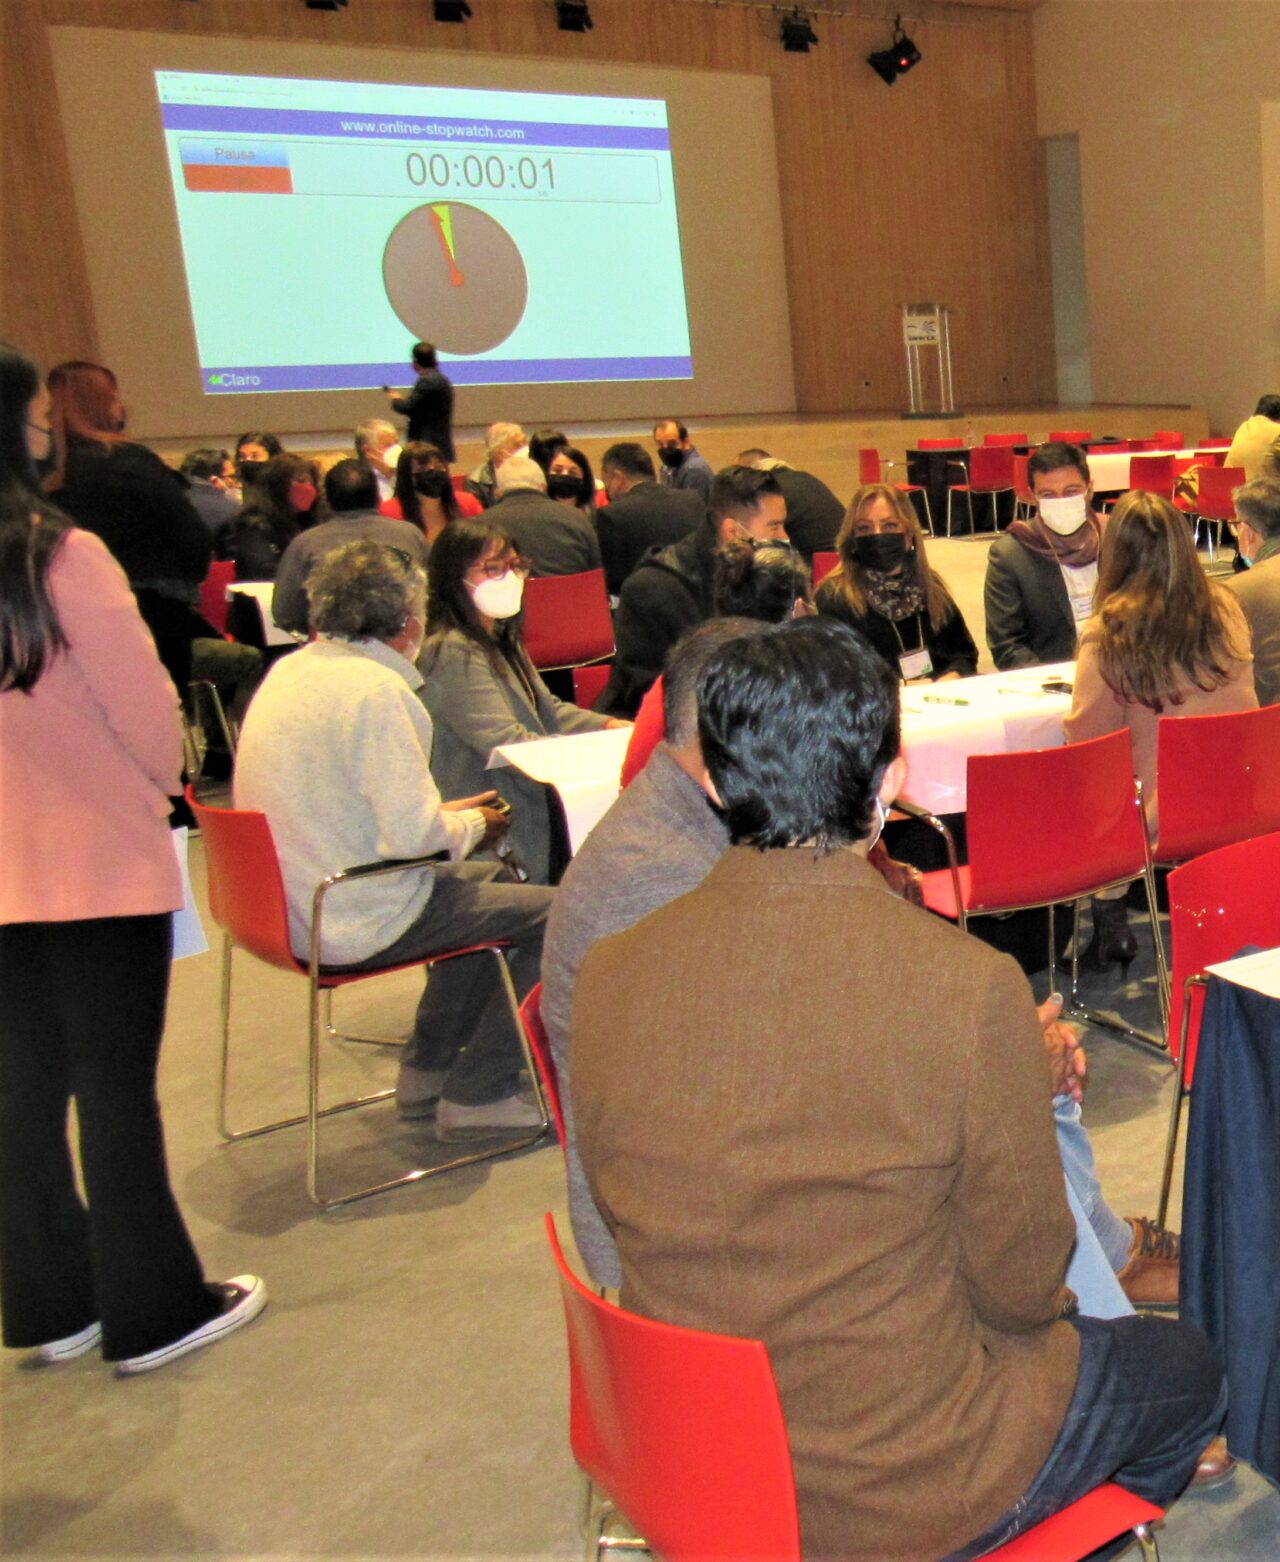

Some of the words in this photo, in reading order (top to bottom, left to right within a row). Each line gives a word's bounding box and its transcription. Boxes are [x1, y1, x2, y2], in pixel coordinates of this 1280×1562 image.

[340, 119, 526, 140] www.online-stopwatch.com
[406, 152, 555, 190] 00:00:01
[220, 373, 261, 387] Claro
